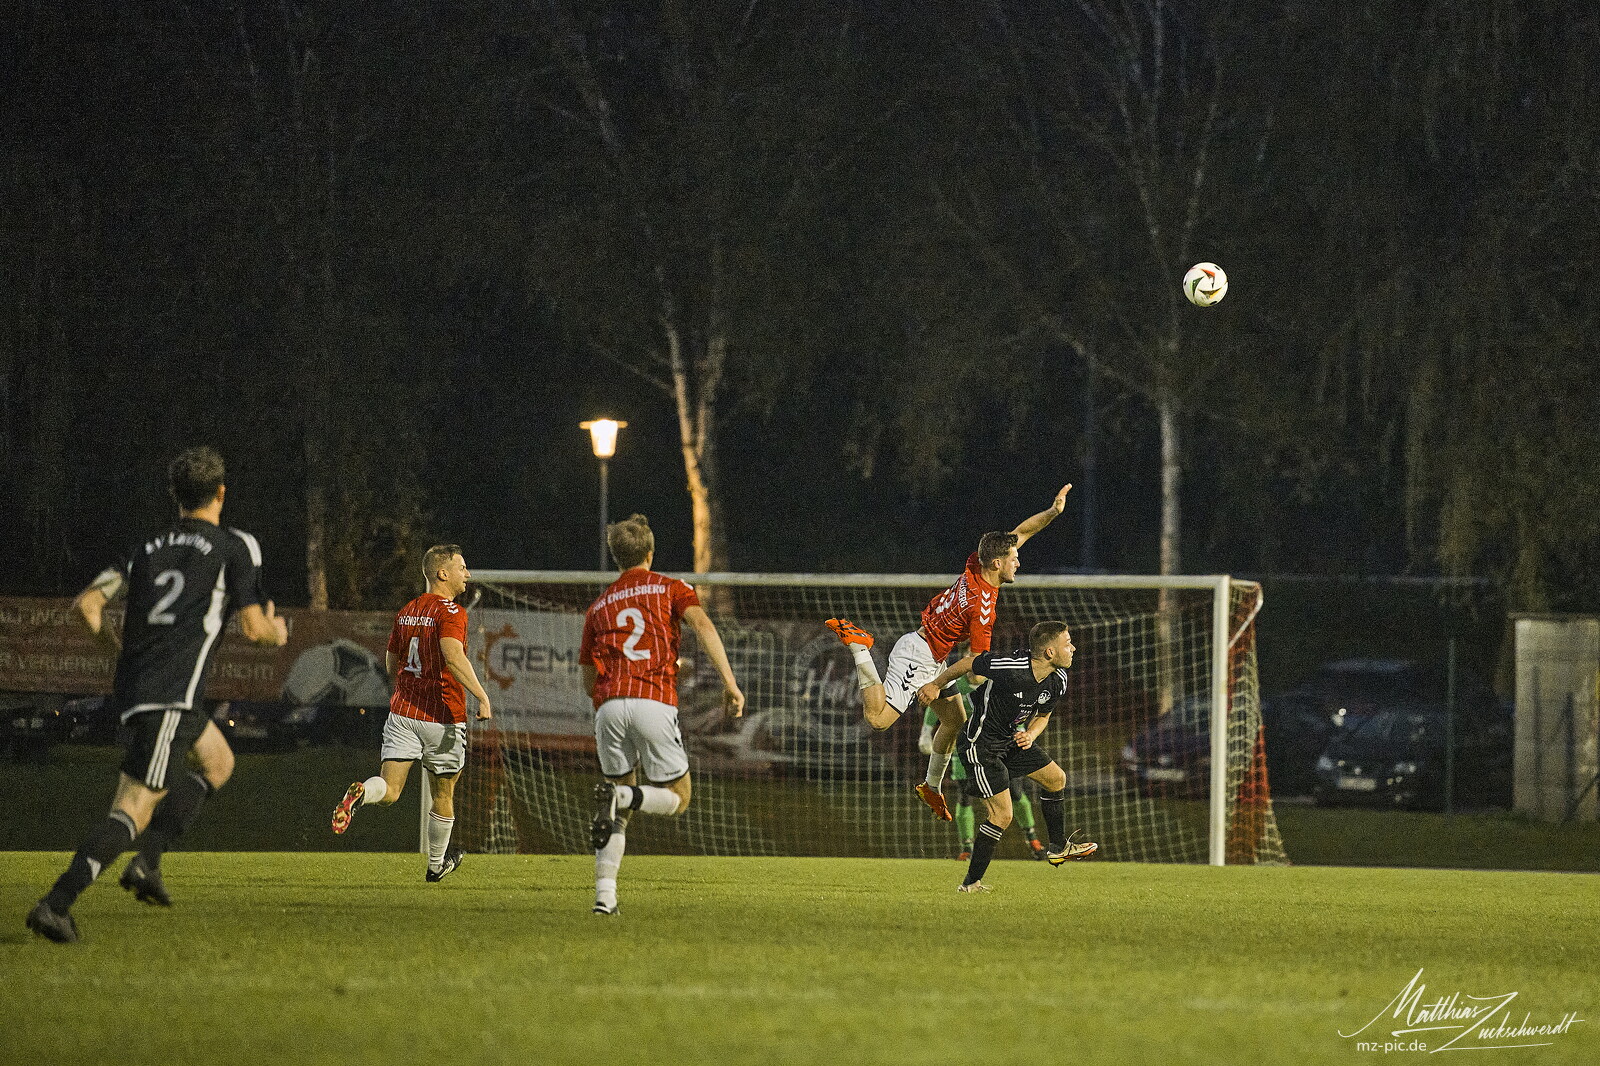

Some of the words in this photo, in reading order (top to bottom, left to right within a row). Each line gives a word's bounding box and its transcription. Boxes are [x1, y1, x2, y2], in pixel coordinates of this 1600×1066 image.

[147, 568, 186, 625] 2
[607, 583, 666, 605] ENGELSBERG
[616, 607, 651, 661] 2
[404, 636, 422, 679] 4
[501, 643, 580, 674] REM
